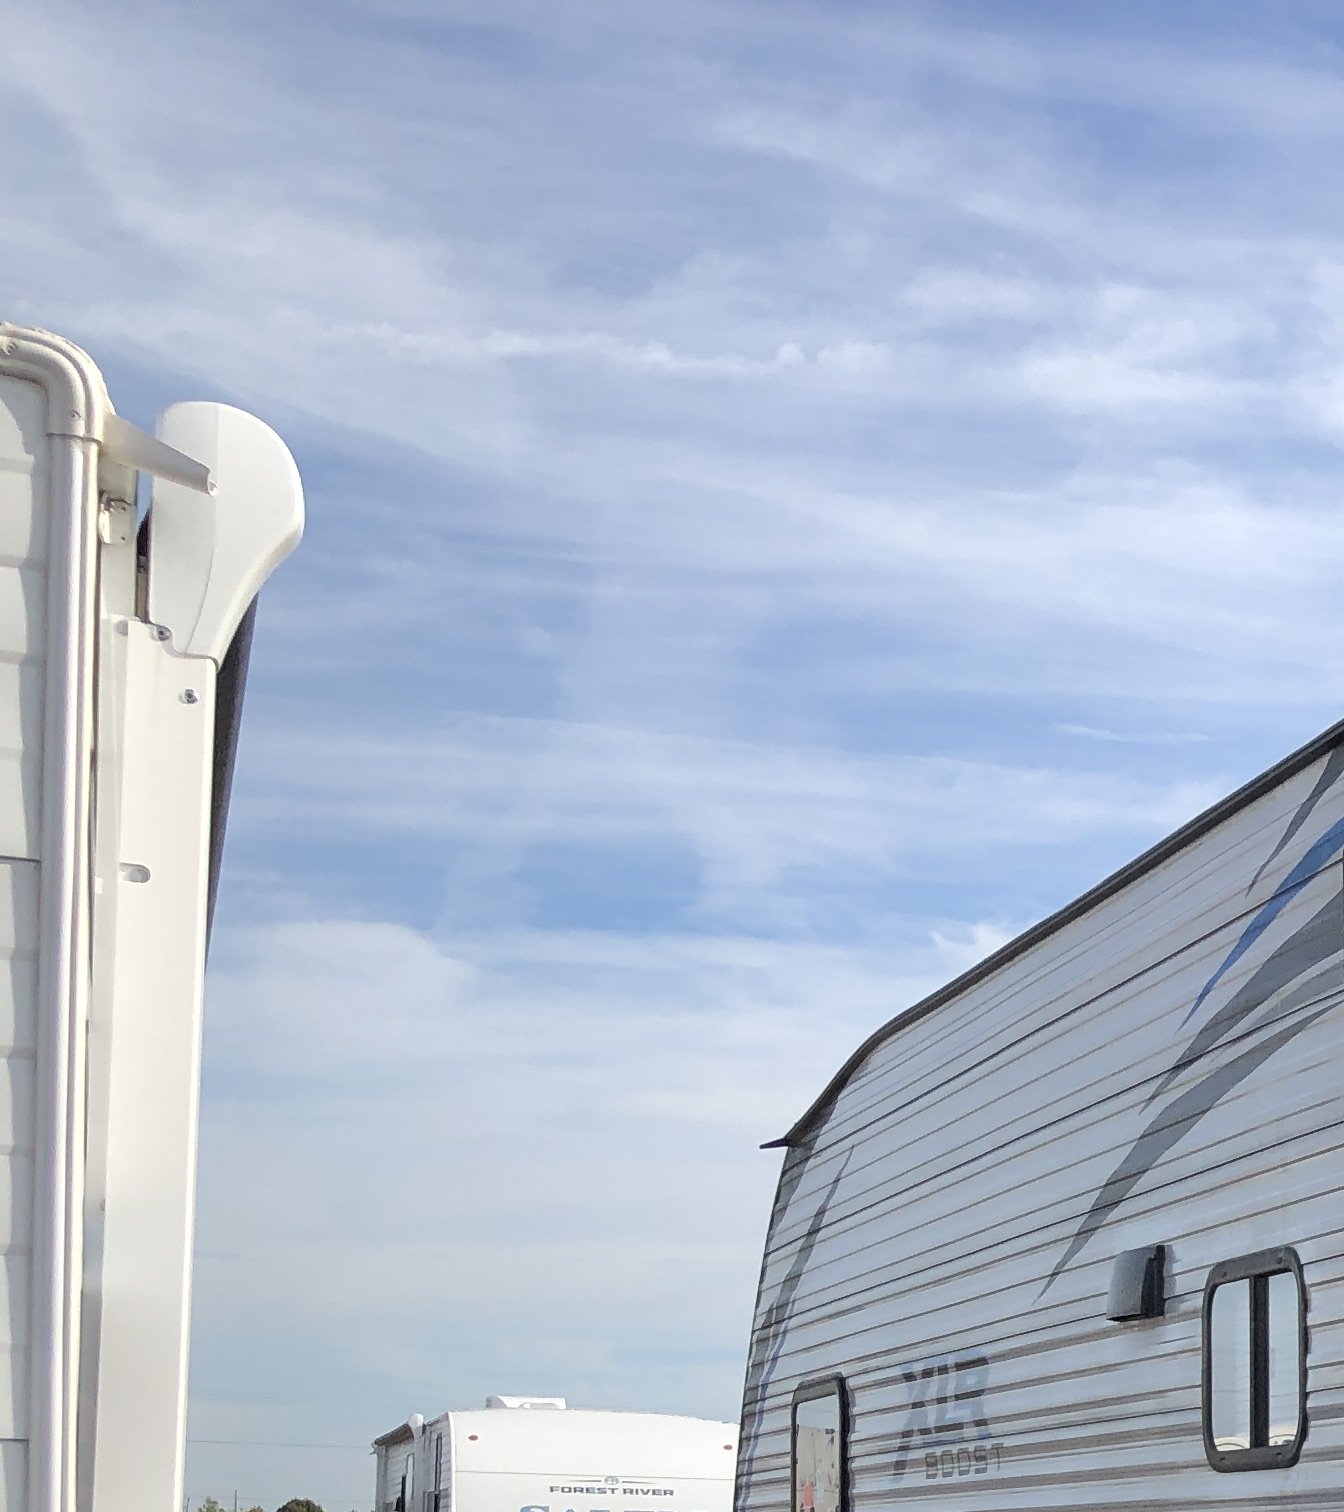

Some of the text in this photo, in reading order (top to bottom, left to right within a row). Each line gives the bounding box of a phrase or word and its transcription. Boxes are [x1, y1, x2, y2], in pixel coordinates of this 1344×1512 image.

[889, 1349, 992, 1484] XLR
[924, 1442, 1004, 1480] BOOST
[549, 1485, 674, 1497] FOREST RIVER
